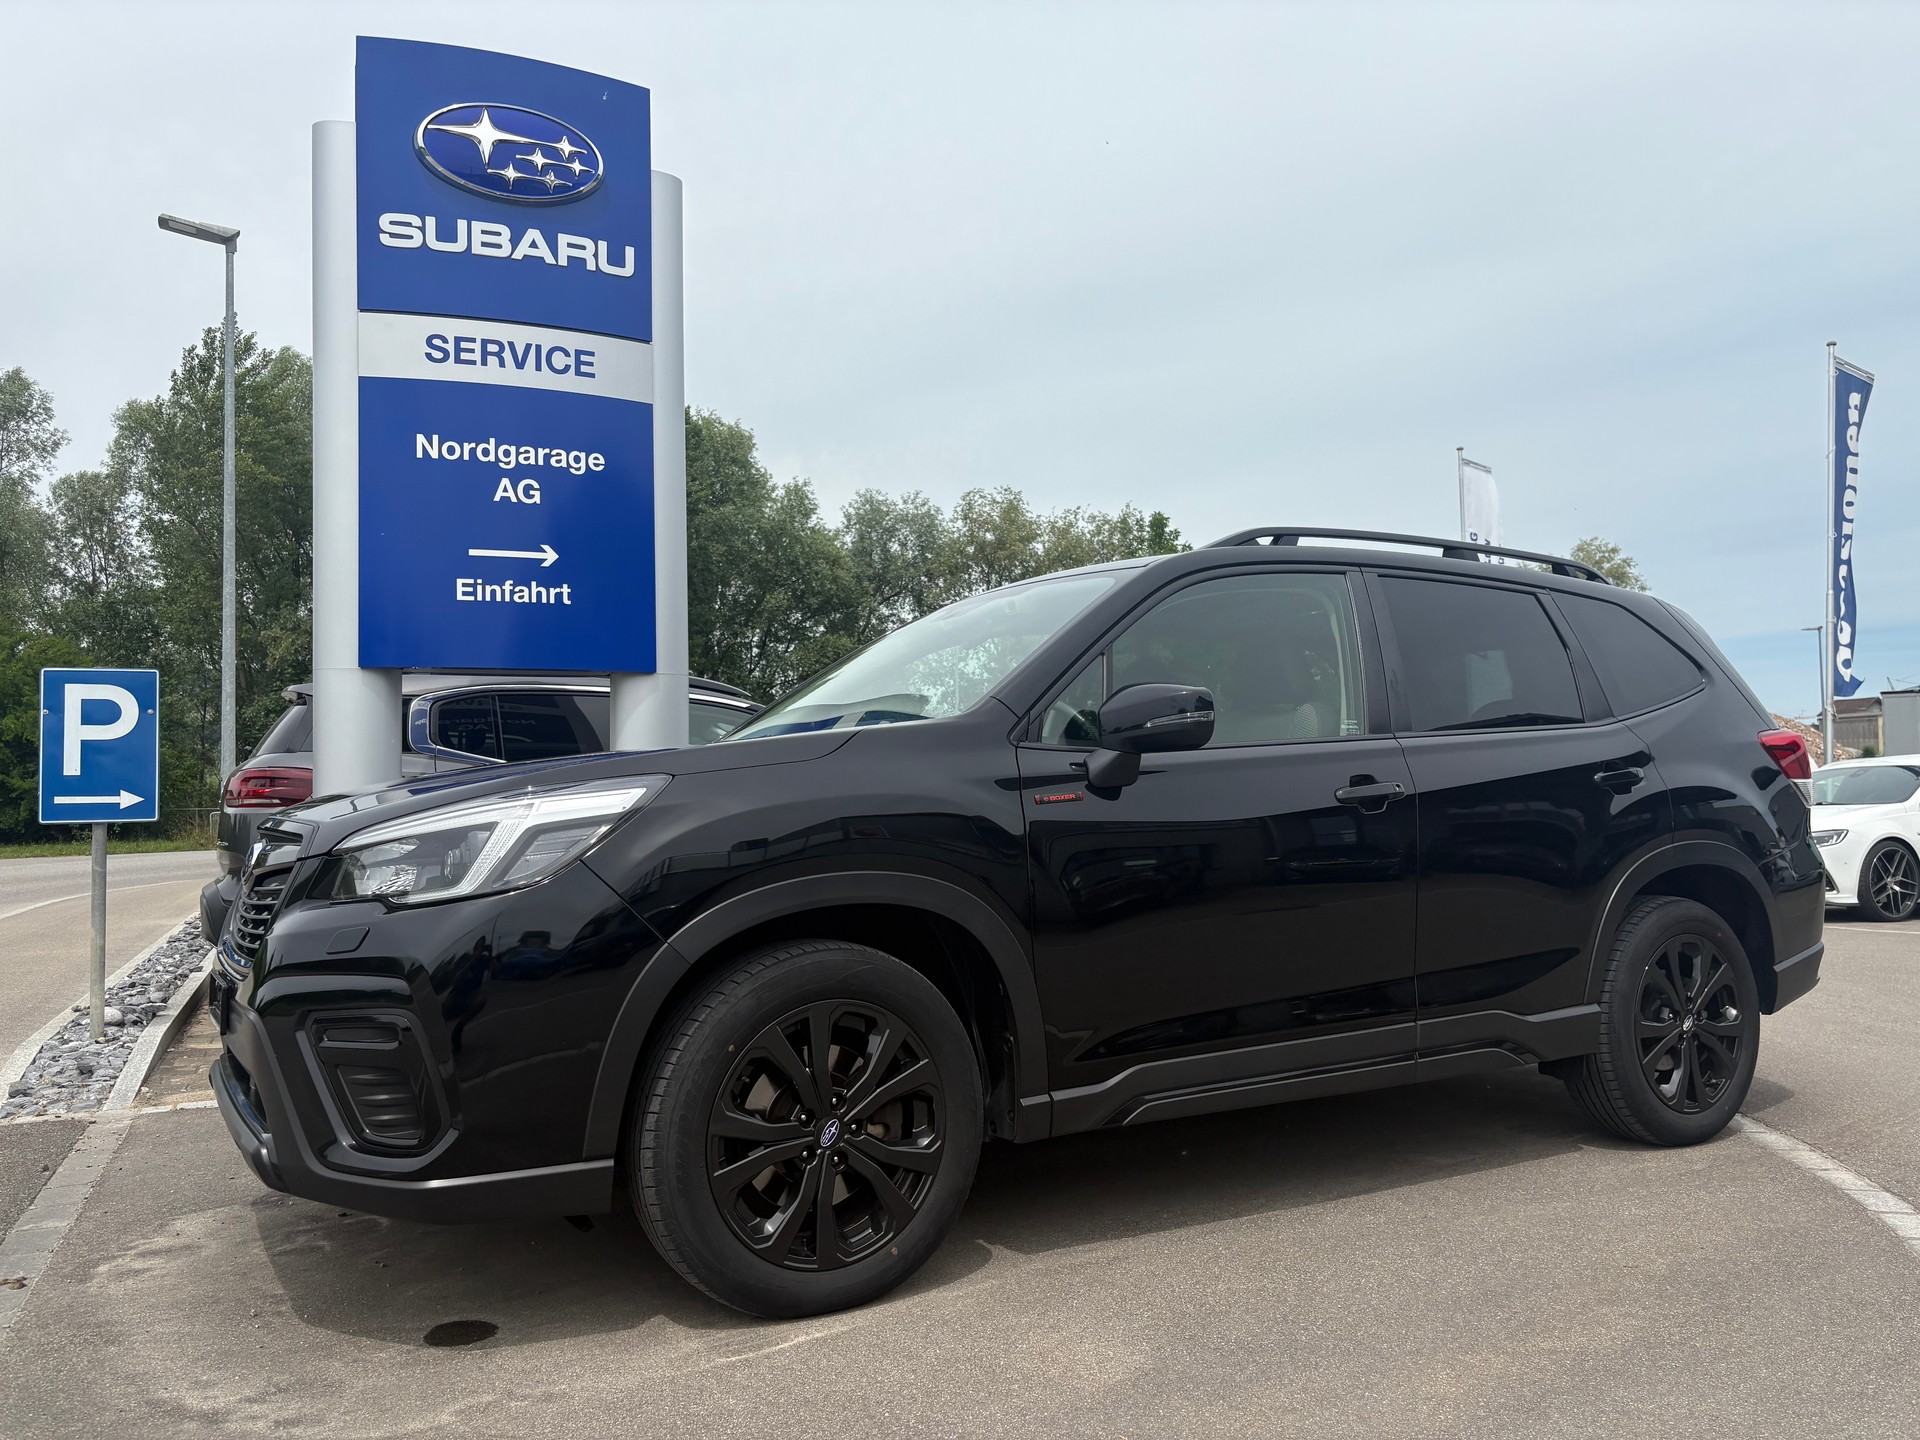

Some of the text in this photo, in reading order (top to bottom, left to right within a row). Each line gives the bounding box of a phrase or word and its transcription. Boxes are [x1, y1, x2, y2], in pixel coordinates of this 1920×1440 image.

[378, 212, 636, 278] SUBARU
[424, 333, 596, 379] SERVICE
[415, 433, 606, 475] Nordgarage
[493, 477, 541, 504] AG
[455, 578, 572, 605] Einfahrt
[63, 683, 139, 776] P
